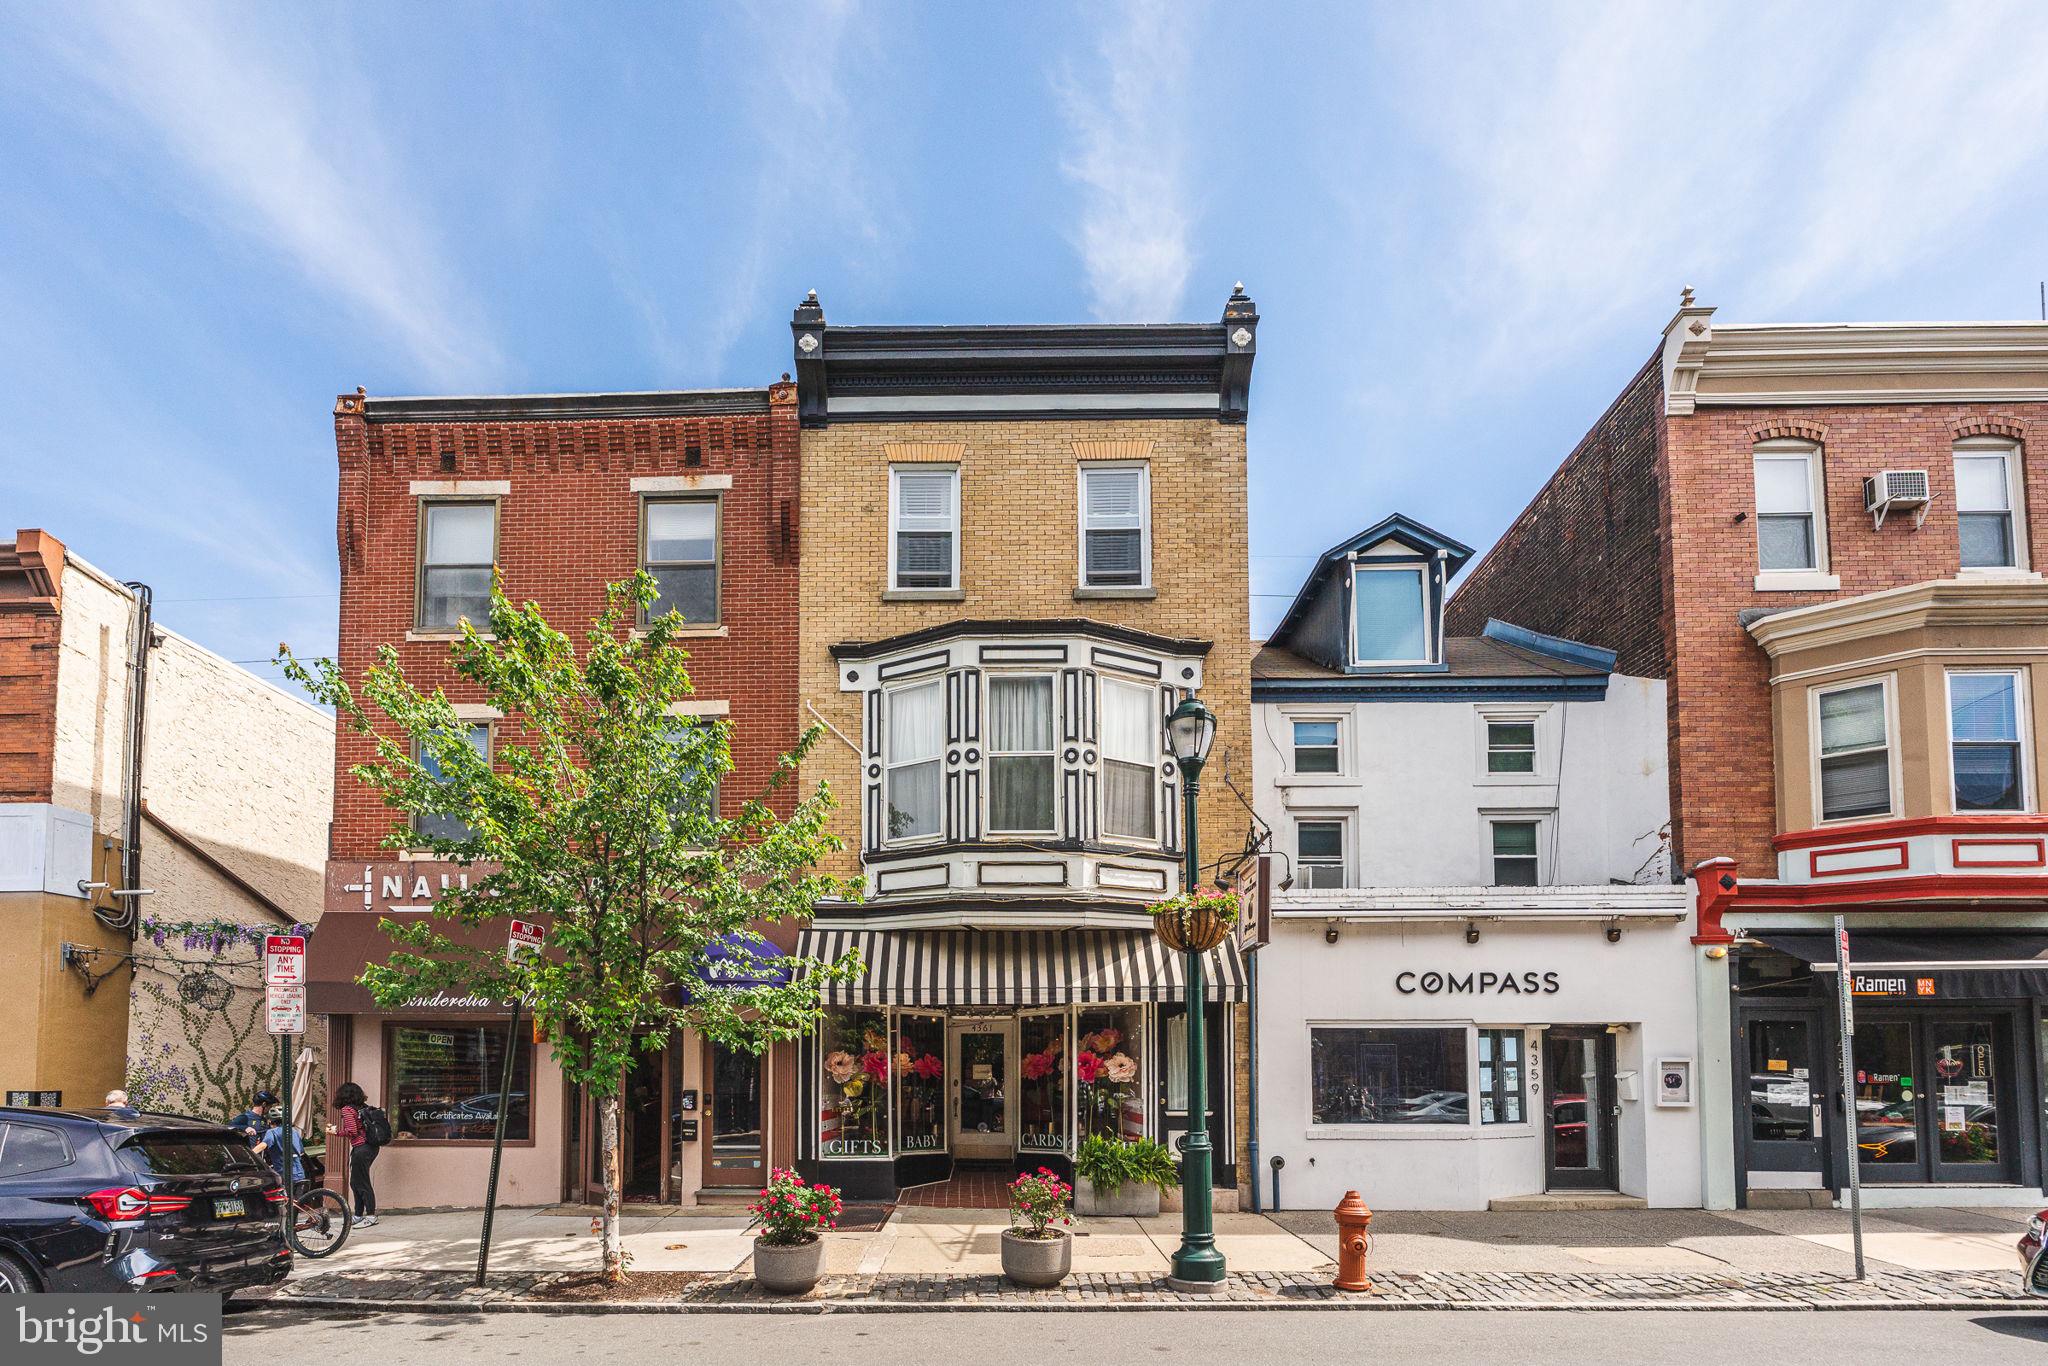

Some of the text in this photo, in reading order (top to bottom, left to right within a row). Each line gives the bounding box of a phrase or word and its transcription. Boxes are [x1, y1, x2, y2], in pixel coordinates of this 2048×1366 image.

[382, 873, 501, 898] NAIL
[521, 924, 534, 935] NO
[512, 931, 542, 944] STOPPING
[269, 945, 301, 954] STOPPING
[277, 956, 294, 964] ANY
[277, 965, 295, 973] TIME
[1395, 971, 1560, 994] COMPASS
[972, 1024, 993, 1032] 4361
[430, 1033, 454, 1045] OPEN
[1530, 1040, 1540, 1095] 4359
[413, 1110, 429, 1121] Gift
[429, 1110, 474, 1121] Certificates
[906, 1135, 937, 1149] BABY
[1021, 1132, 1063, 1148] CARDS
[829, 1139, 882, 1154] GIFTS
